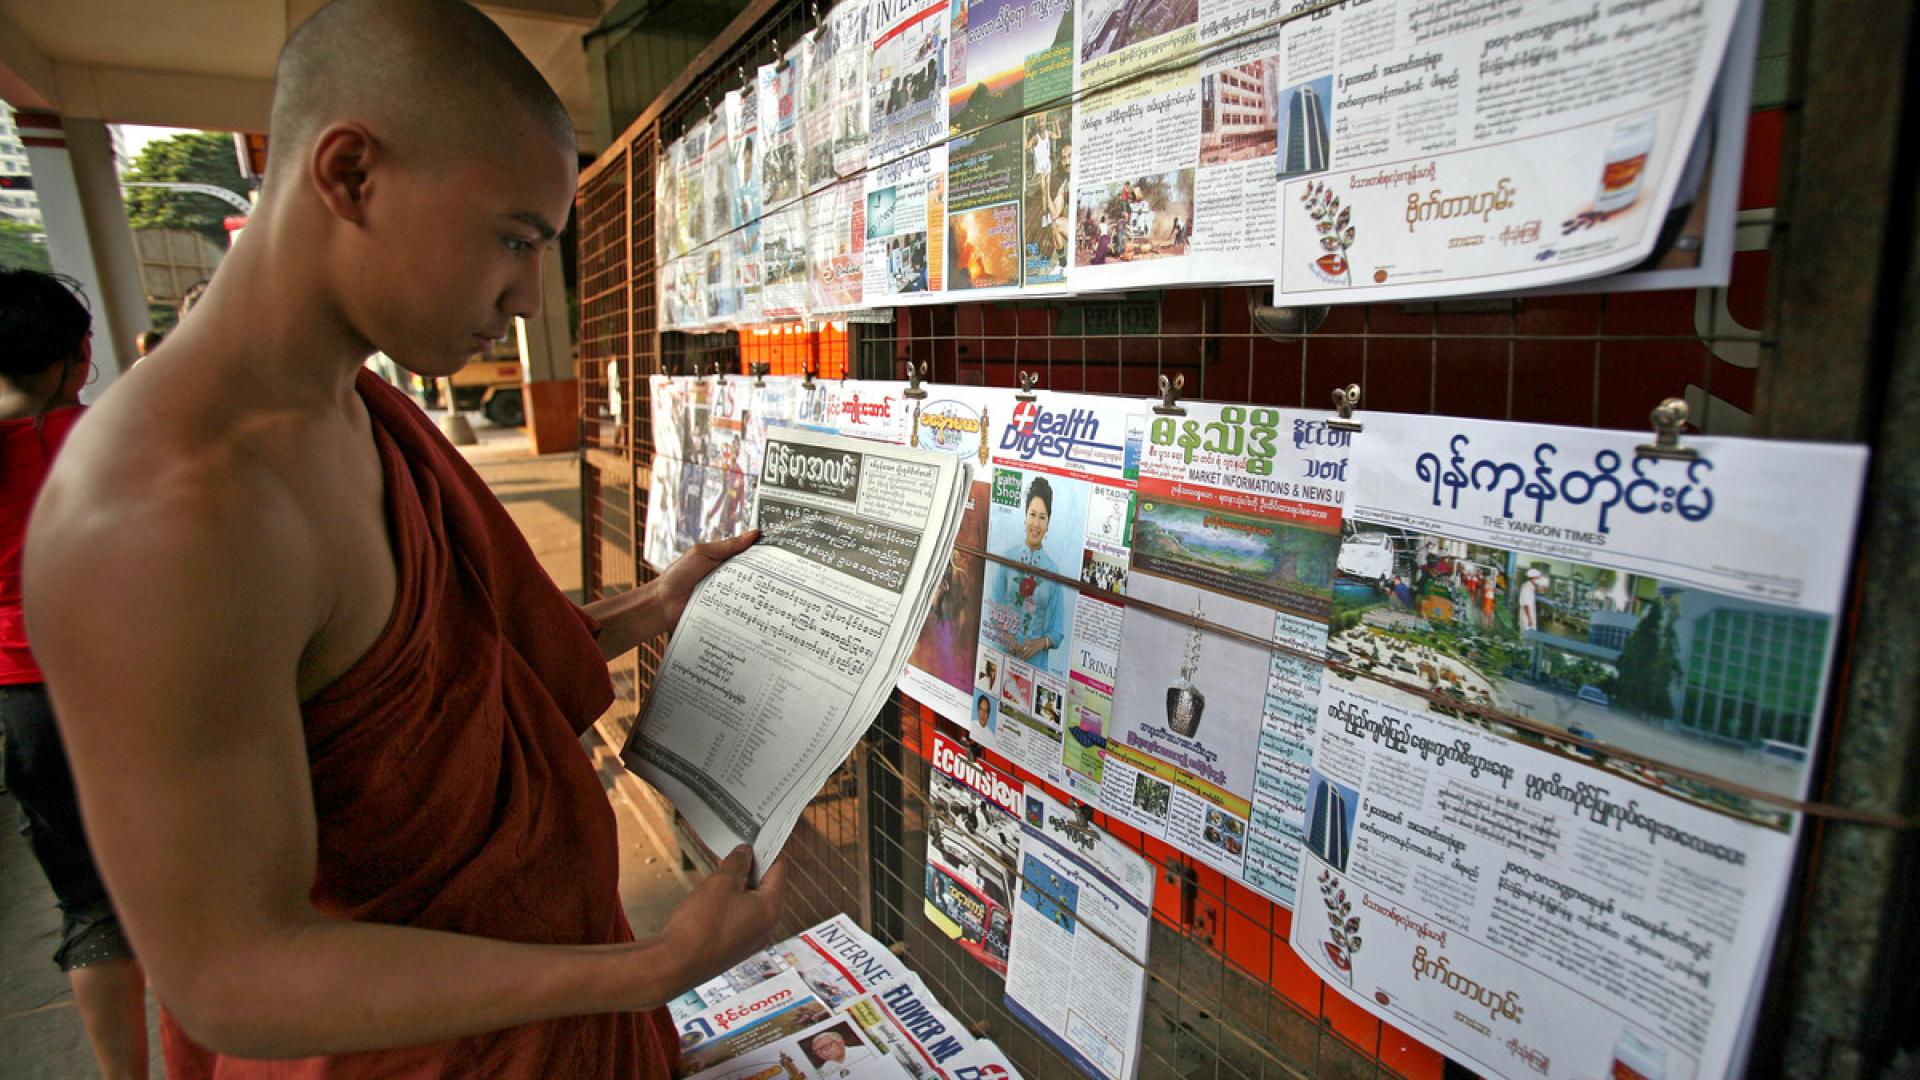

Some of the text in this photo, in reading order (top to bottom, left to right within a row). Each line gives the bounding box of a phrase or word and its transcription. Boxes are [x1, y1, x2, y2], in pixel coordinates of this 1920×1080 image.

[1188, 468, 1222, 484] MARKET
[1222, 474, 1290, 497] INFORMATIONS
[1292, 483, 1300, 497] &
[1302, 484, 1332, 502] NEWS
[1481, 515, 1607, 546] THE YANGON TIMES
[1081, 649, 1117, 679] TRINA
[816, 923, 893, 986] INTERNE
[882, 983, 946, 1043] FLOWER
